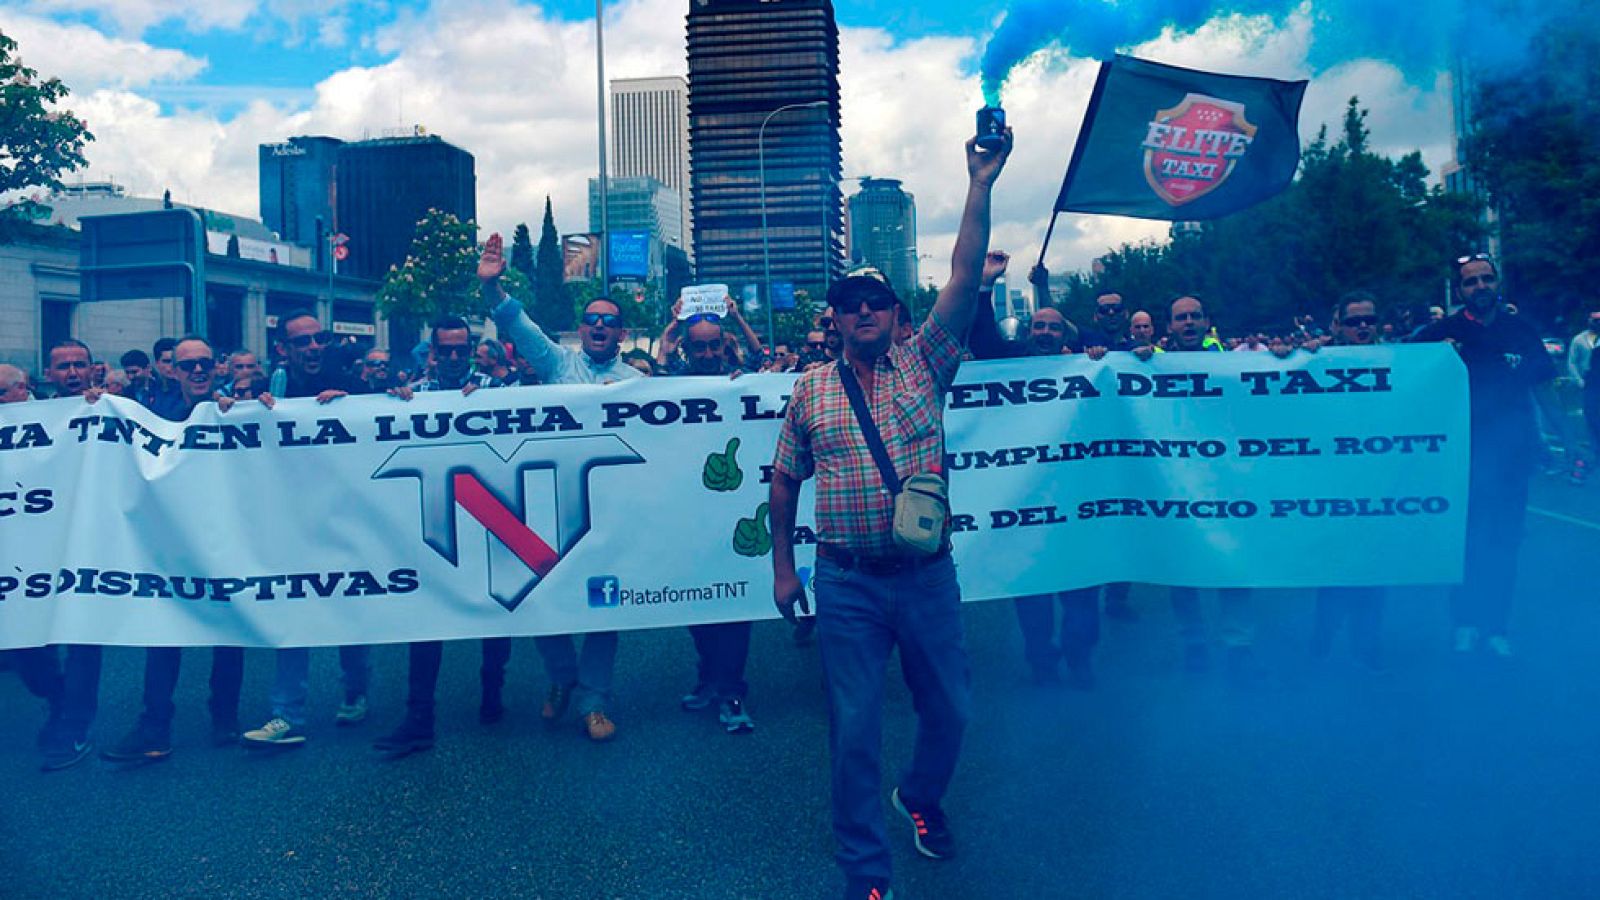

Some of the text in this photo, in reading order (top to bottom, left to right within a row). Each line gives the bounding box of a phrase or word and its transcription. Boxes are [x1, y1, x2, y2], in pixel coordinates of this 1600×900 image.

[1141, 116, 1254, 158] ÉLITE
[1161, 158, 1217, 181] TAXI
[69, 415, 175, 456] TNT
[180, 423, 262, 450] EN
[278, 419, 357, 446] LA
[375, 405, 583, 442] LUCHA
[602, 397, 723, 428] POR
[946, 375, 1101, 410] ENSA
[1117, 372, 1223, 398] DEL
[1241, 368, 1392, 395] TAXI
[946, 434, 1447, 471] UMPLIMIENTO DEL ROTT
[990, 506, 1067, 529] DEL
[1077, 498, 1257, 521] SERVICIO
[1270, 496, 1450, 519] PUBLICO
[619, 581, 749, 606] PlataformaTNT
